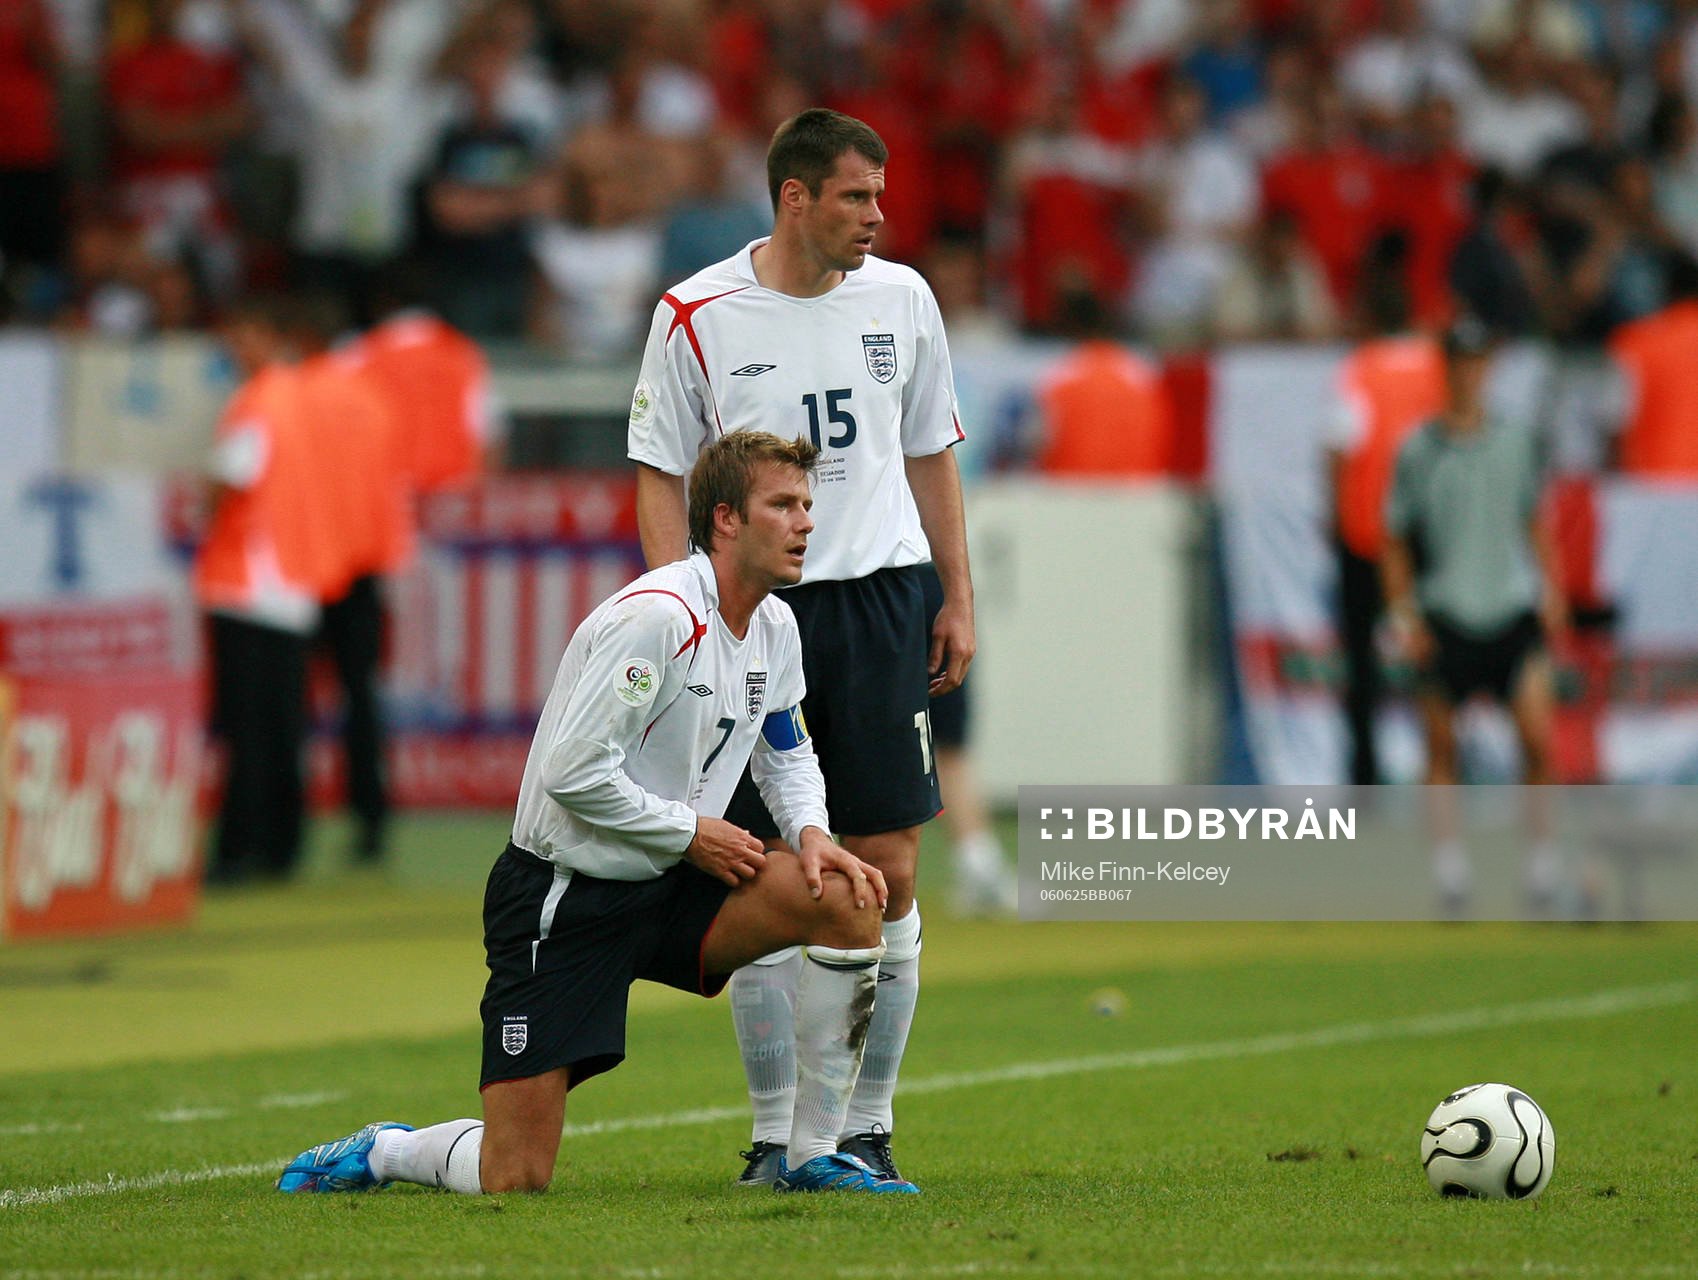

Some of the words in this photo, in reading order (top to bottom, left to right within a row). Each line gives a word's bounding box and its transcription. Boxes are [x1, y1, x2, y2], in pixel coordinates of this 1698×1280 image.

[801, 388, 857, 451] 15
[701, 717, 737, 774] 7
[914, 706, 935, 788] 1
